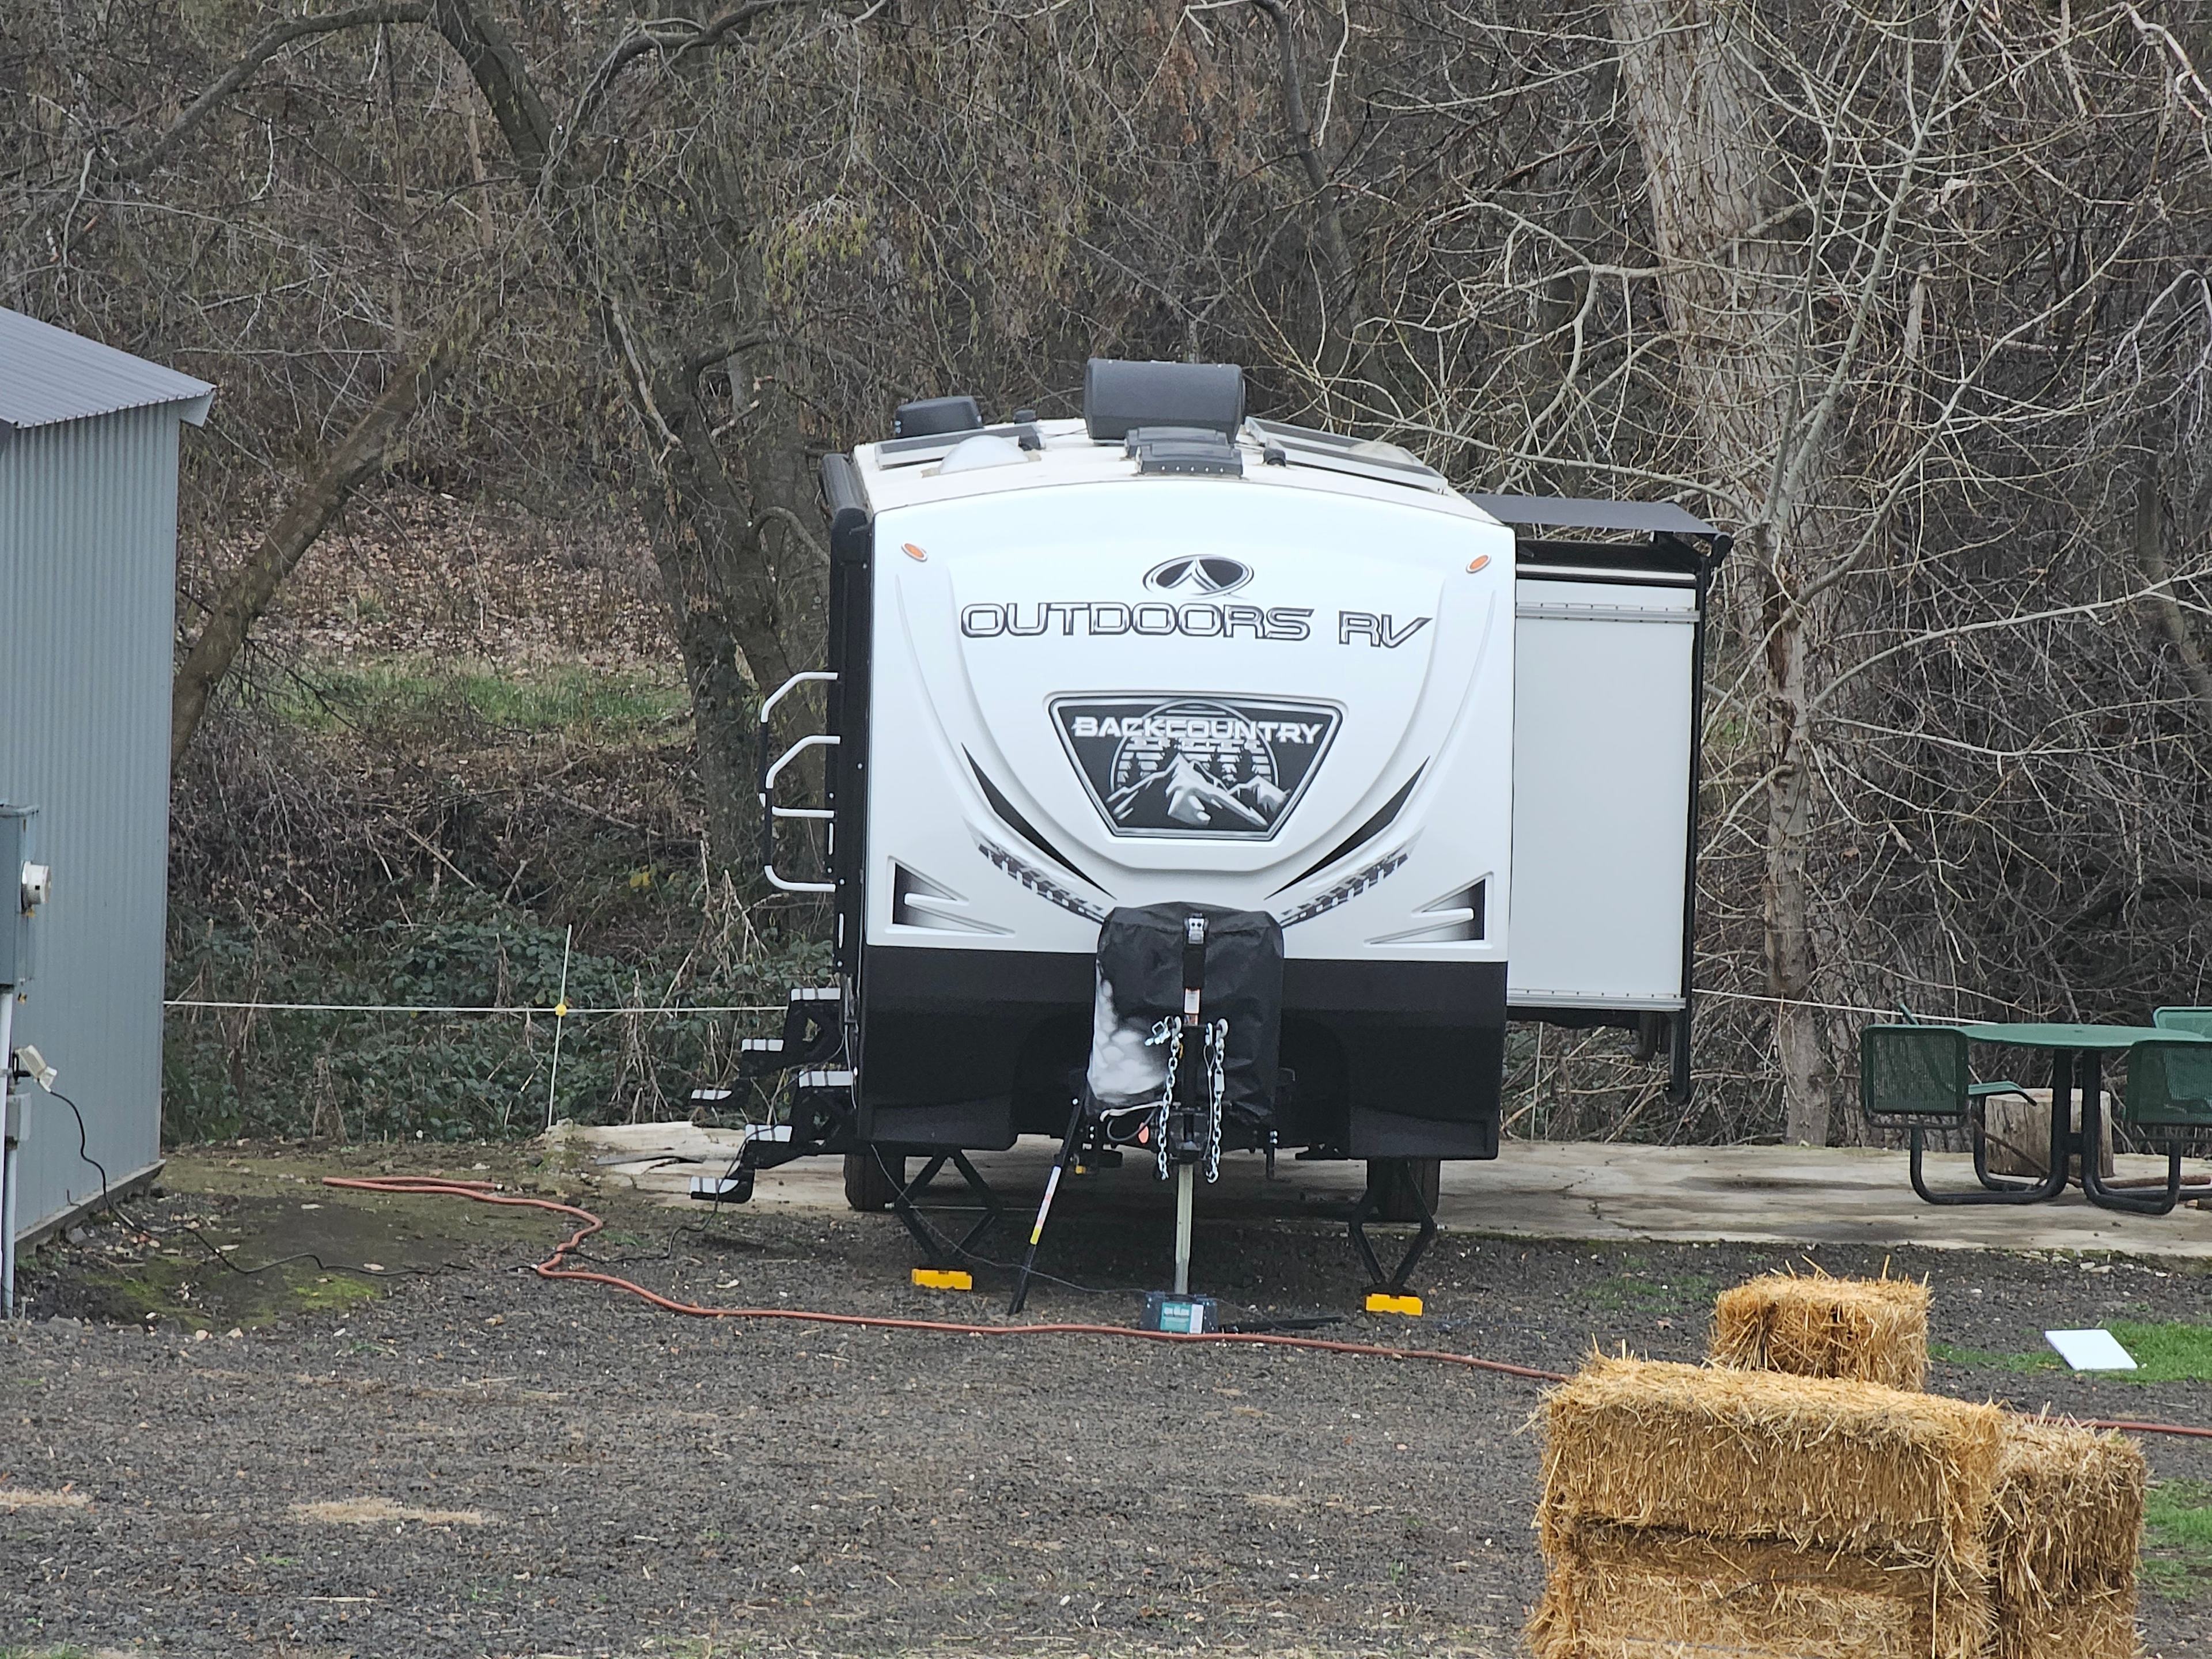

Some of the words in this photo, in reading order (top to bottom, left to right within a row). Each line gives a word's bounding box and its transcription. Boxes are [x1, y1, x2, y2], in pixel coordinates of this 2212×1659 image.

[961, 602, 1315, 641] OUTDOORS
[1339, 611, 1433, 649] RV
[1071, 716, 1323, 744] BACKCOUNTRY
